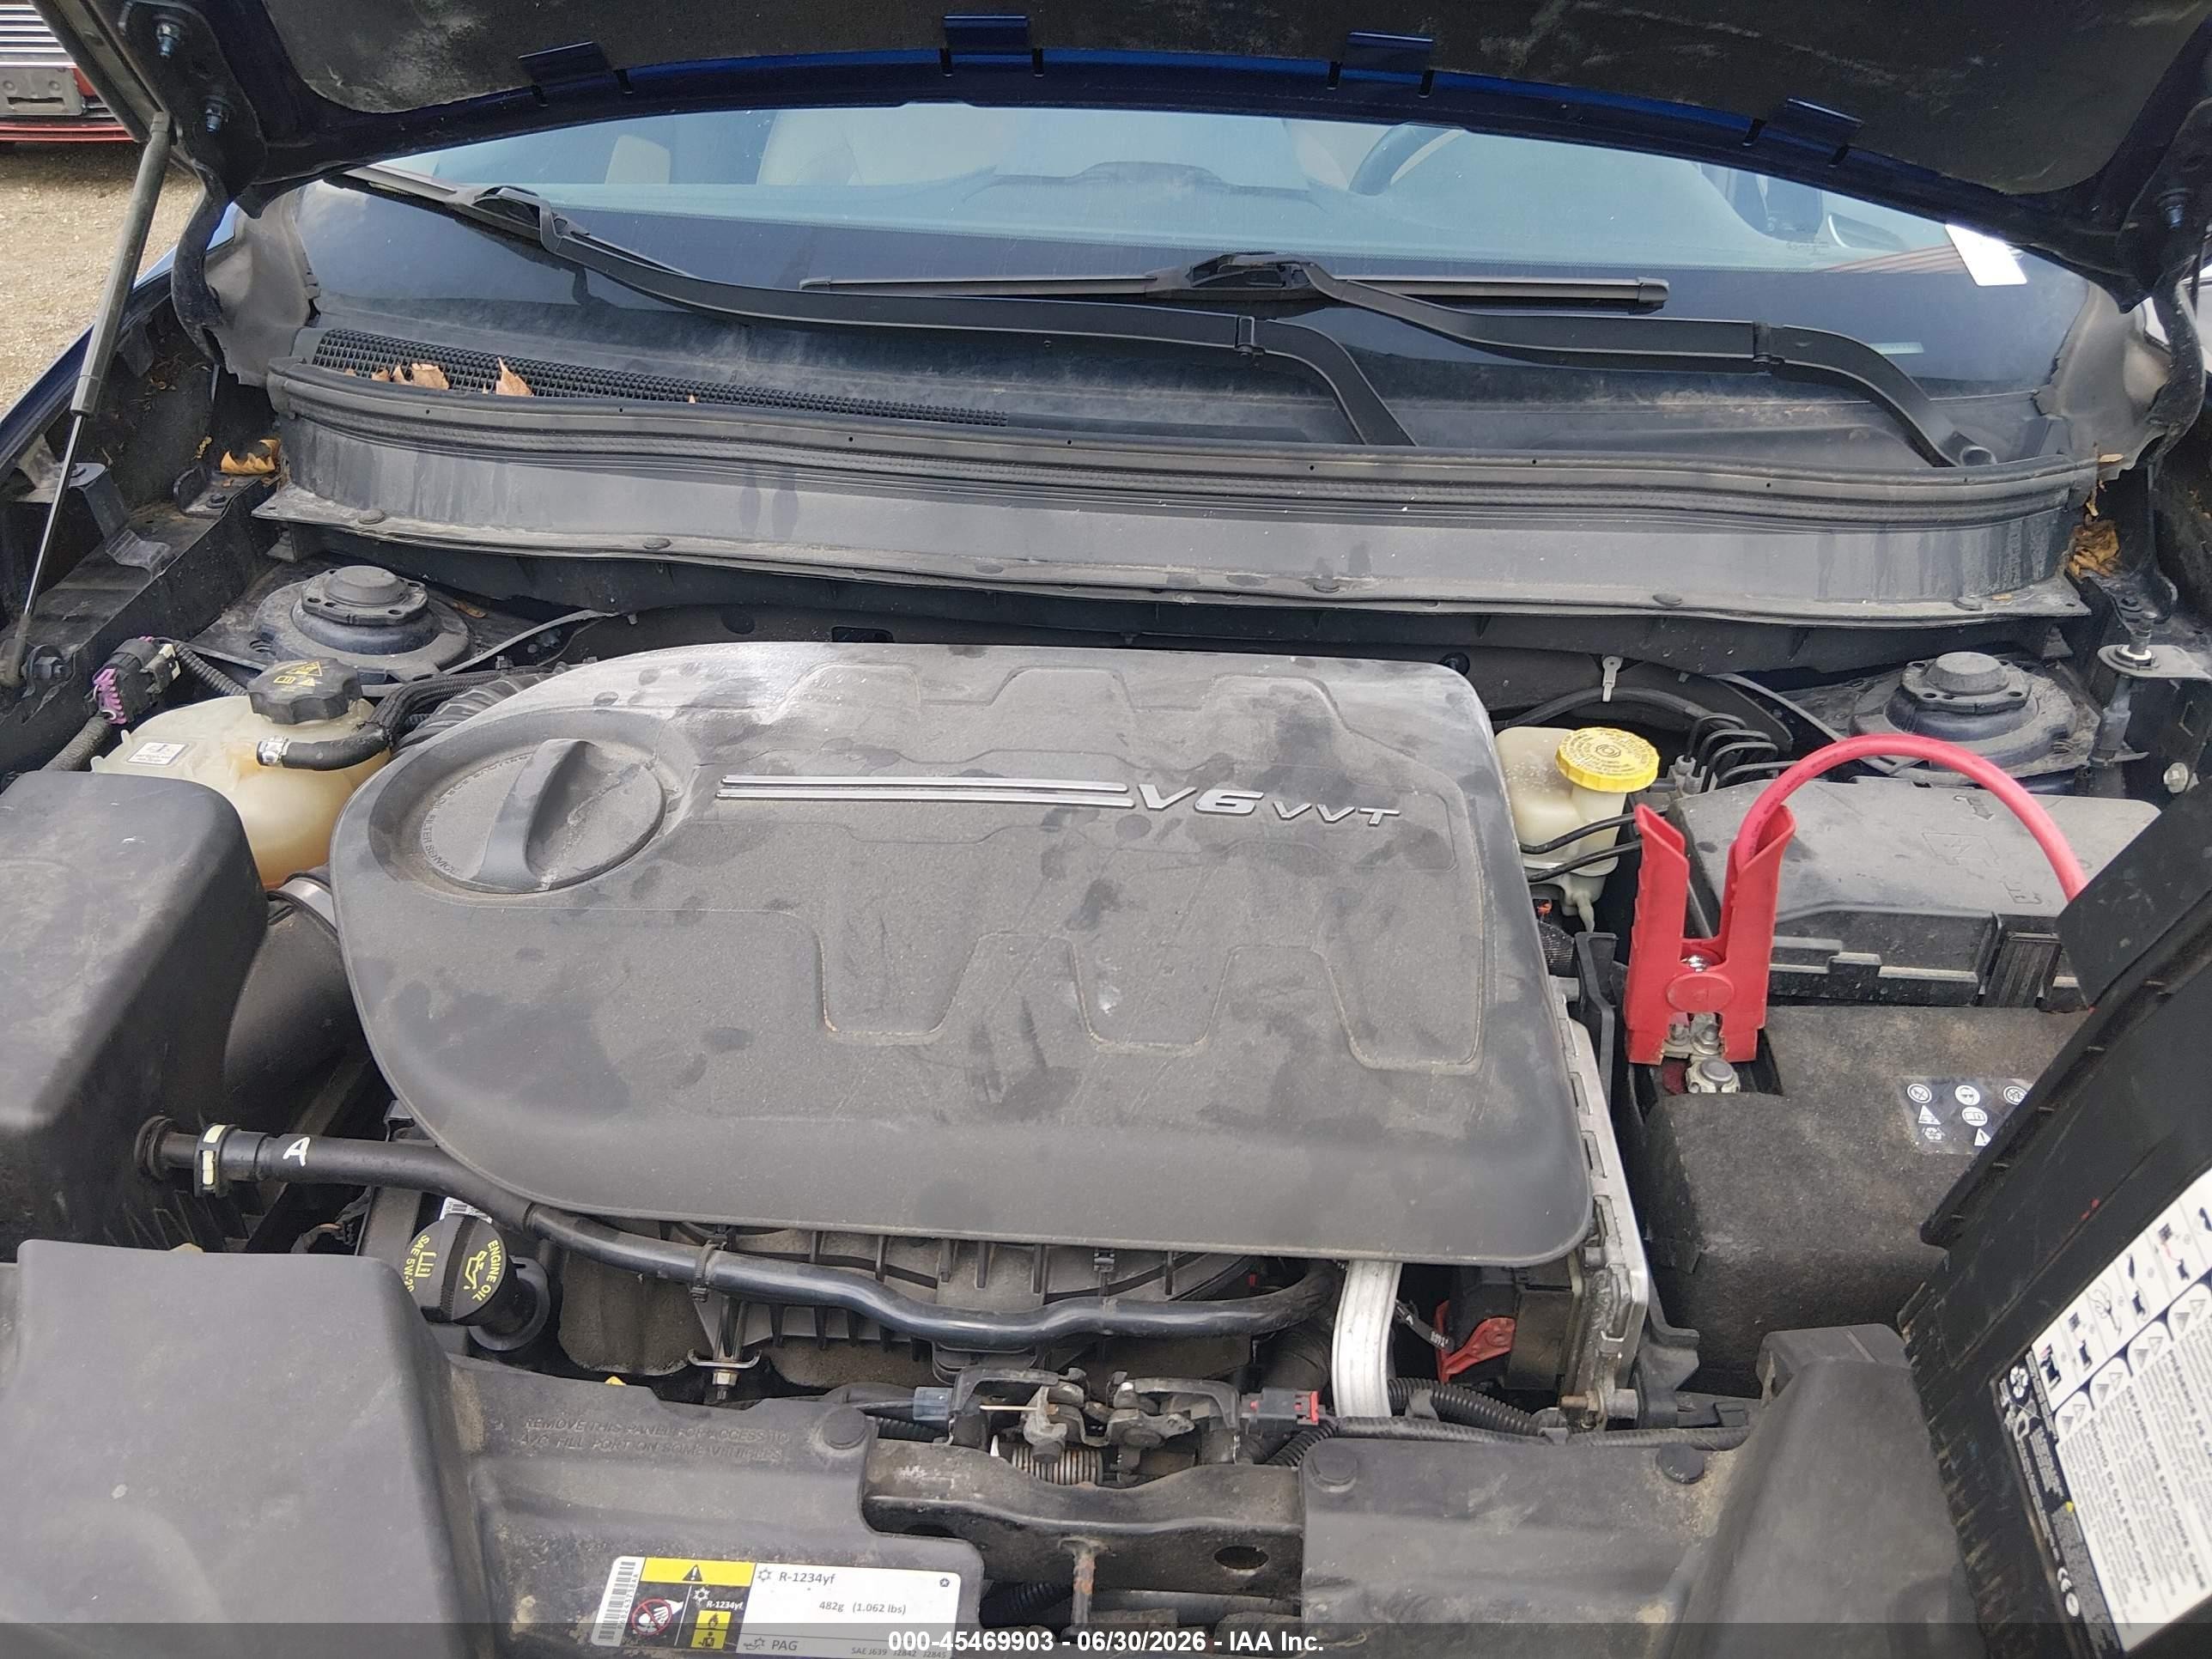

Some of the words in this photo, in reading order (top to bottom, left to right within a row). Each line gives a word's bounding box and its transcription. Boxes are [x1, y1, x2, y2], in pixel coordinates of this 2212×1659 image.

[1138, 782, 1265, 816] V6
[1273, 800, 1401, 826] VVT
[422, 814, 436, 843] FILTER
[283, 1136, 311, 1167] A
[410, 1235, 430, 1256] SAE
[486, 1239, 501, 1284] ENGINE
[472, 1284, 492, 1302] OIL
[525, 1418, 587, 1433] REMOVE
[589, 1421, 623, 1433] THIS
[625, 1423, 670, 1437] PANEL
[708, 1428, 767, 1443] ACCESS
[520, 1431, 550, 1446] A/C
[556, 1436, 584, 1449] FILL
[590, 1438, 631, 1452] PORT
[637, 1441, 659, 1453] ON
[660, 1443, 704, 1456] SOME
[779, 1571, 836, 1586] R-1234yf
[707, 1600, 744, 1611] R-1234yf
[818, 1601, 844, 1613] 482g
[852, 1602, 884, 1614] (1.062
[887, 1603, 907, 1615] lbs)
[771, 1639, 799, 1651] PAG
